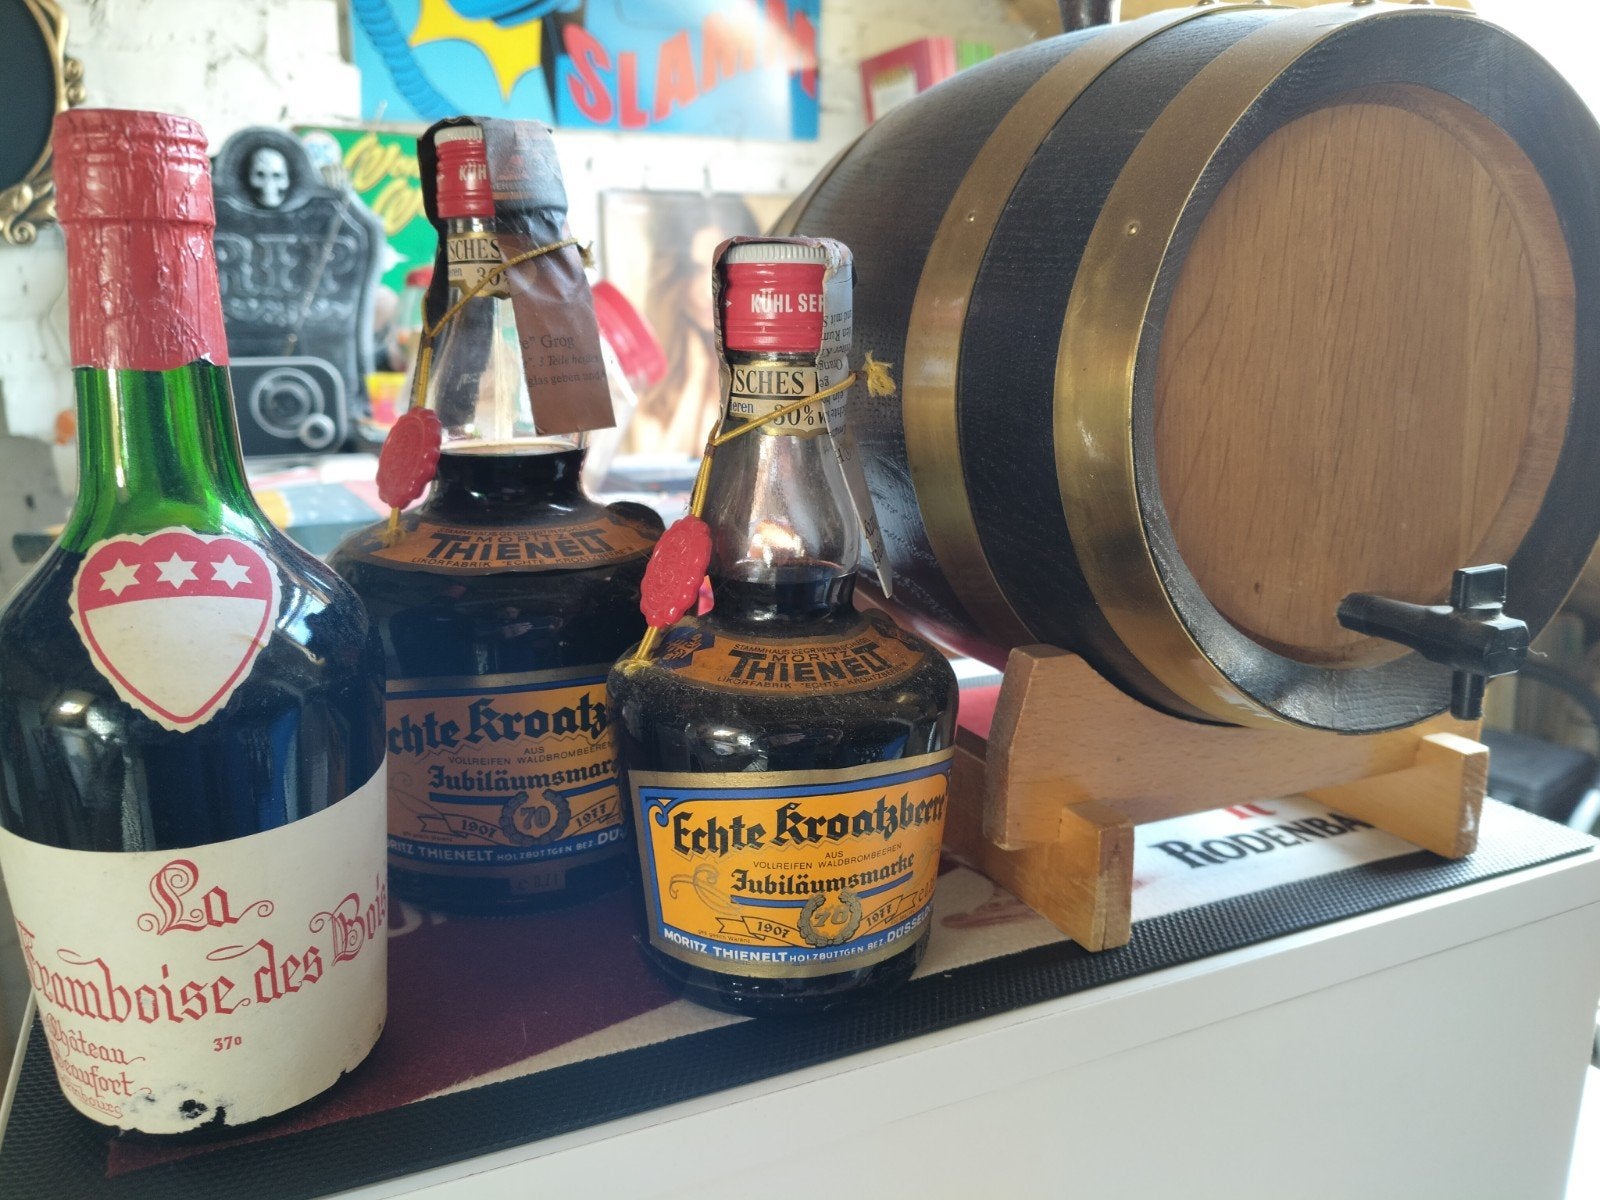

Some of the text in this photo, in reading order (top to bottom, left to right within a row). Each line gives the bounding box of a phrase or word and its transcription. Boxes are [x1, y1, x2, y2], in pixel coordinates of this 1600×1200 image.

[751, 288, 794, 313] KÜHL
[541, 334, 575, 350] Grog
[427, 528, 616, 561] THIENELT
[728, 641, 893, 682] THIENELT
[772, 650, 852, 662] MORITZ
[448, 756, 511, 766] VOLLREIFEN
[523, 746, 545, 755] AUS
[461, 819, 497, 838] 1907
[520, 805, 551, 830] 70
[673, 811, 767, 858] Echte
[415, 845, 494, 861] THIENELT
[753, 843, 902, 871] VOLLREIFEN WALDBROMBEEREN
[825, 851, 844, 860] AUS
[137, 858, 275, 936] La
[757, 921, 790, 939] 1907
[866, 904, 892, 927] 1977
[664, 928, 708, 954] MORITZ
[712, 946, 788, 963] THIENELT
[206, 938, 324, 1005] des
